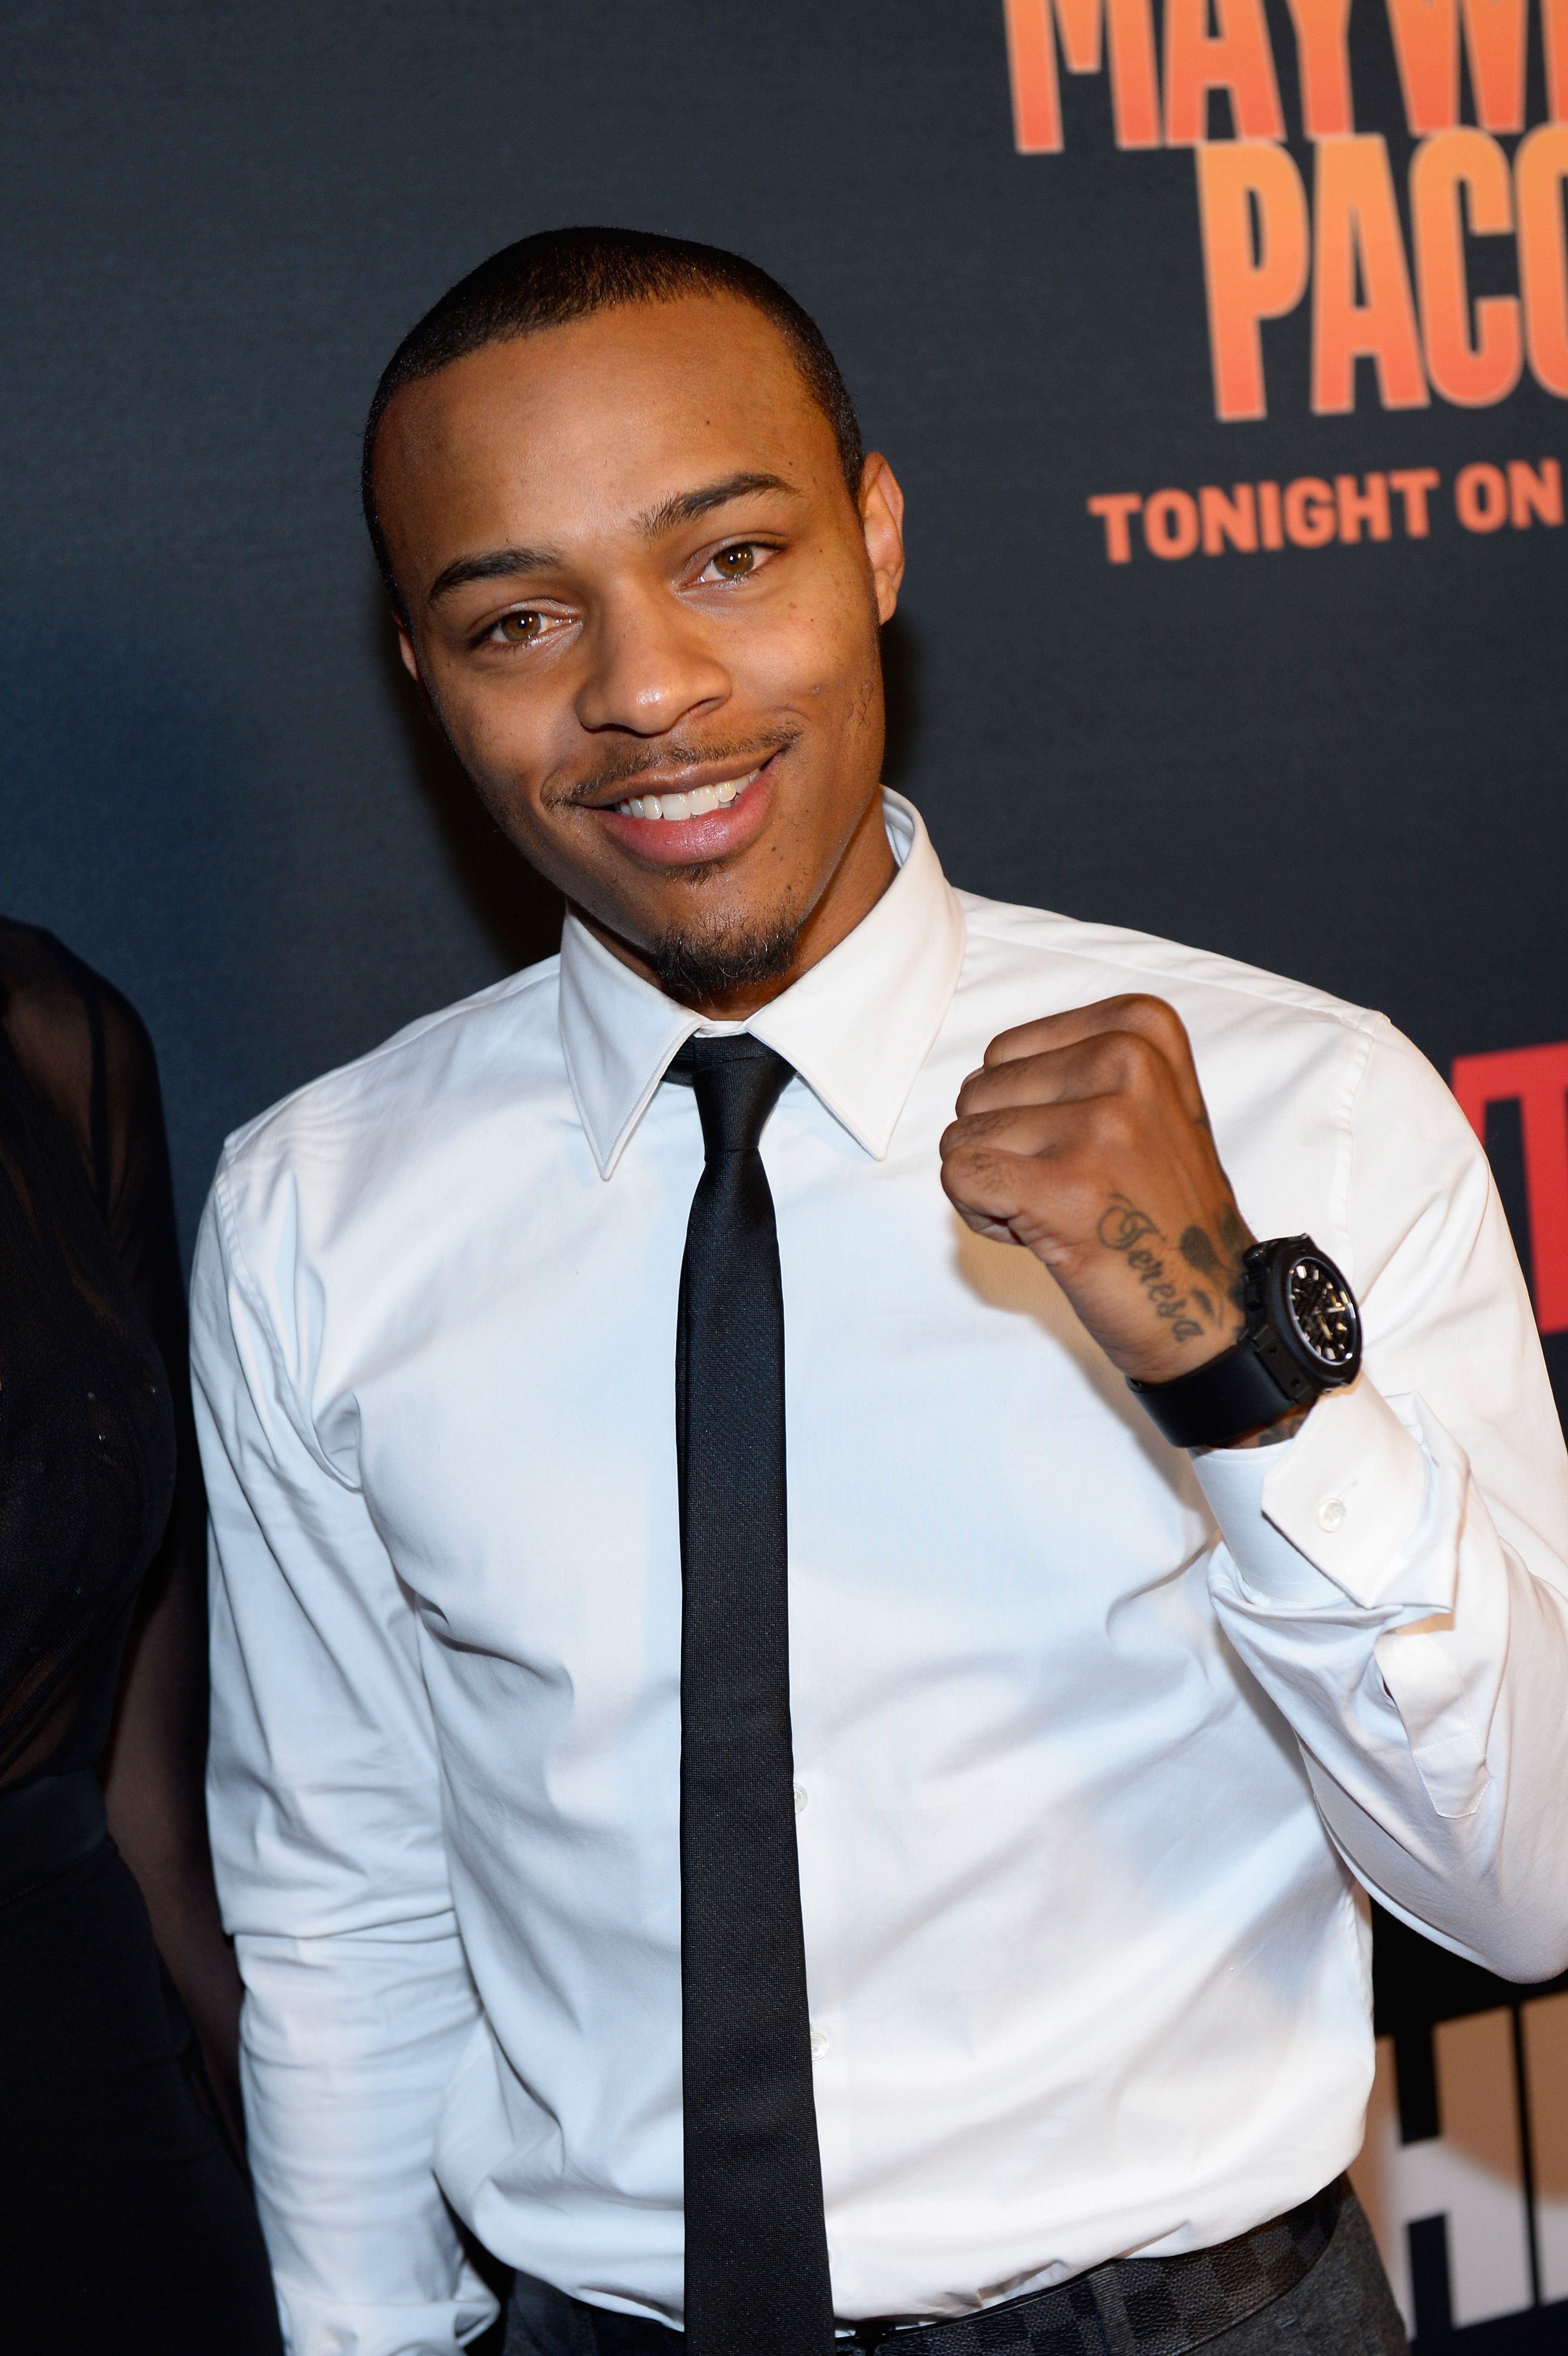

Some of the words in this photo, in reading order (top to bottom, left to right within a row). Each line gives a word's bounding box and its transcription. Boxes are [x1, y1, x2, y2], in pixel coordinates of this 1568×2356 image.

[1003, 0, 1568, 154] MAYW
[1087, 468, 1440, 565] TONIGHT
[1454, 457, 1565, 534] ON
